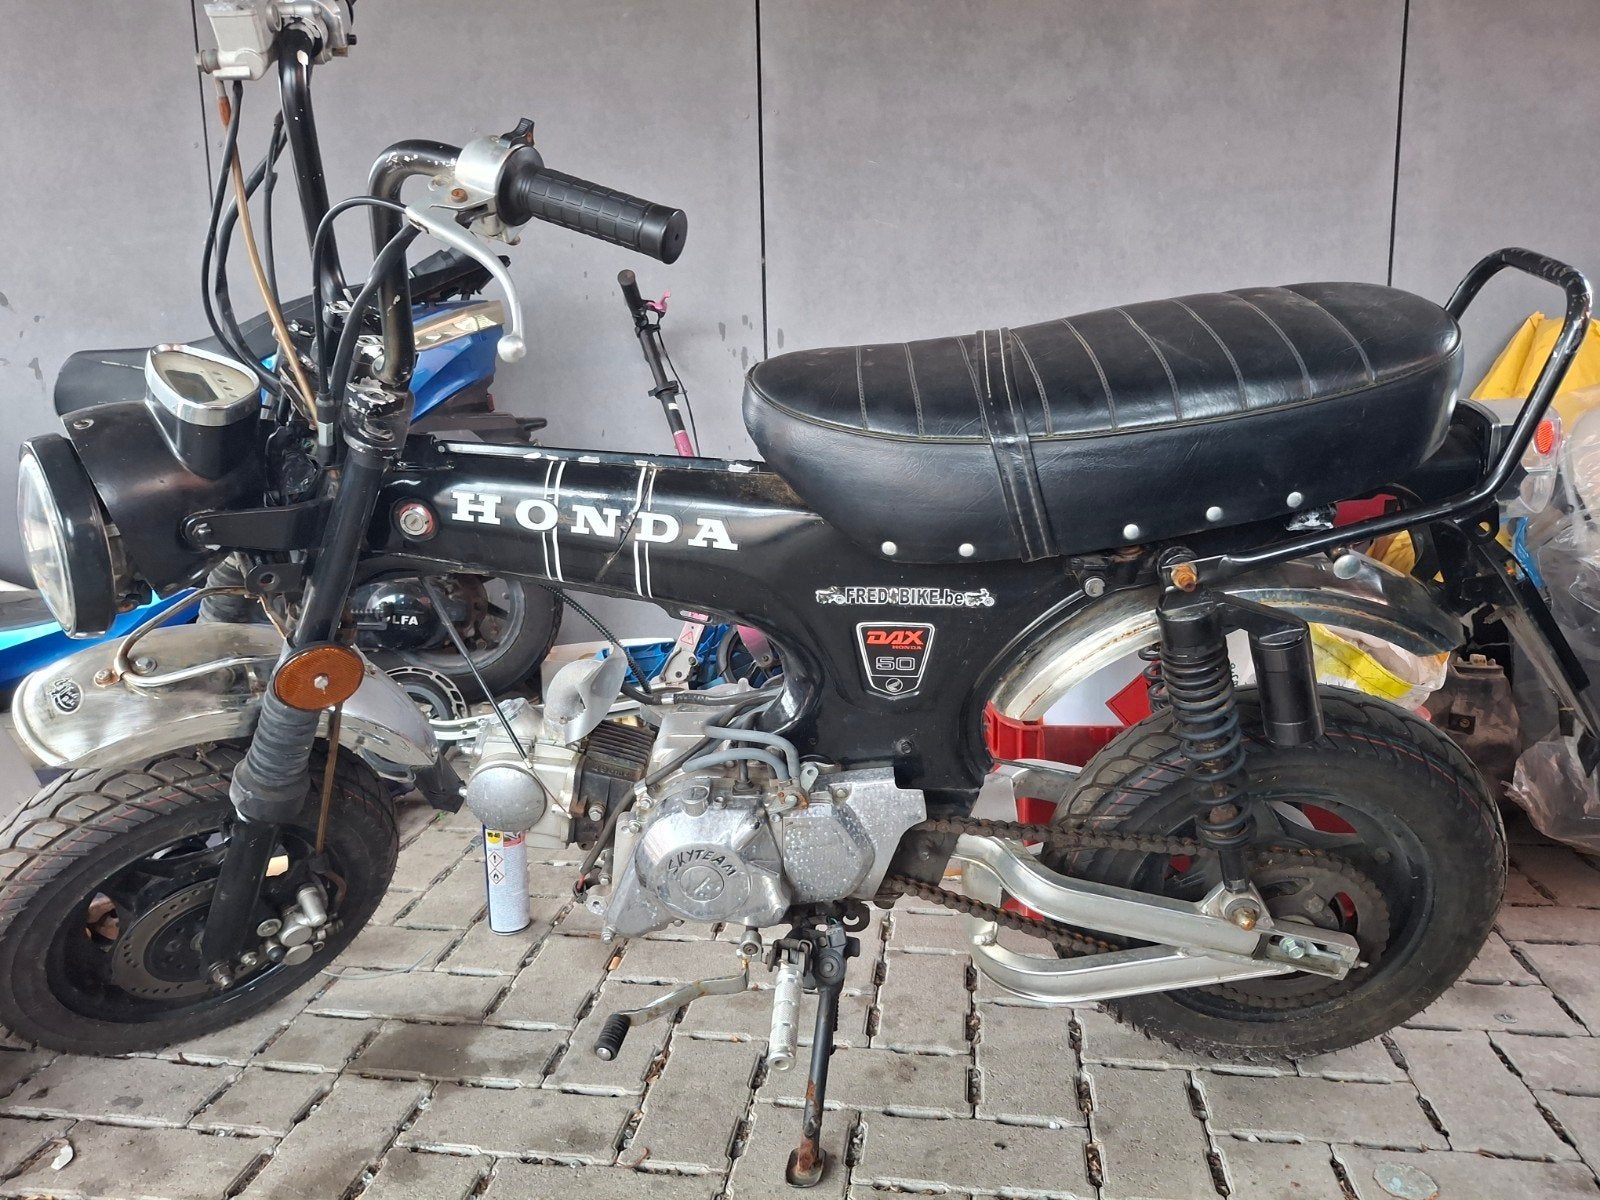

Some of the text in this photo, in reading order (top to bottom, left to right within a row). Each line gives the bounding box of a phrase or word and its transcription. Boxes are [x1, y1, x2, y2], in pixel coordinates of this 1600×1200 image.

[451, 490, 739, 551] HONDA
[866, 630, 924, 645] DAX
[875, 656, 916, 671] 50
[668, 849, 737, 877] SKYTEAM
